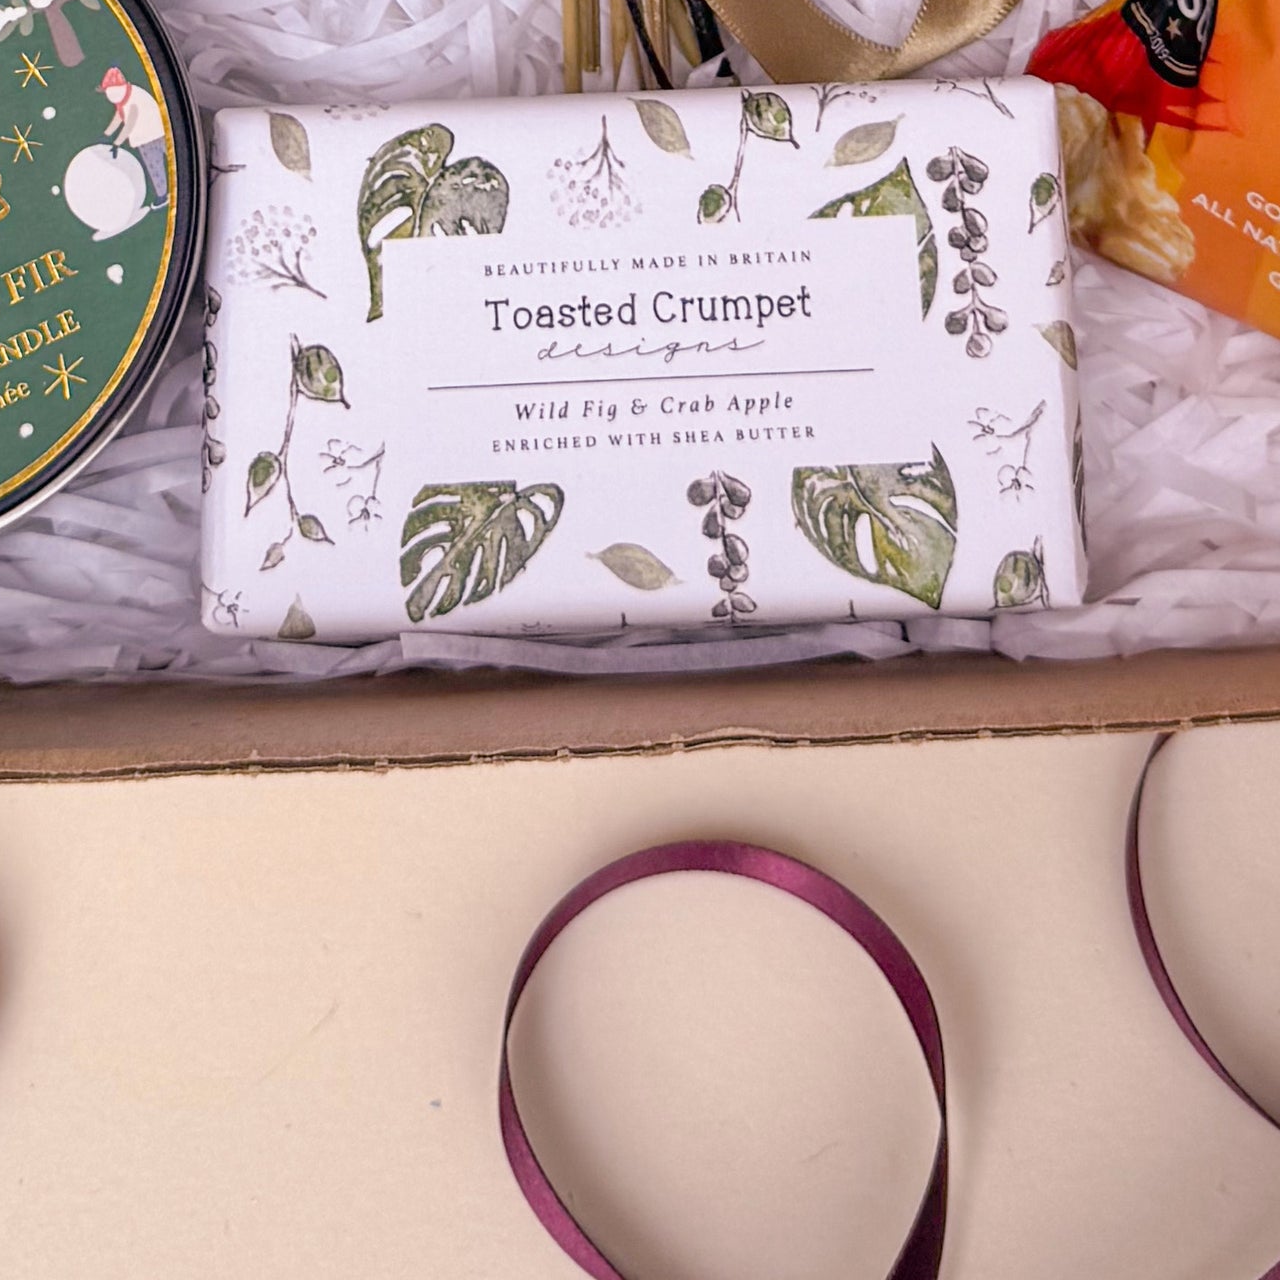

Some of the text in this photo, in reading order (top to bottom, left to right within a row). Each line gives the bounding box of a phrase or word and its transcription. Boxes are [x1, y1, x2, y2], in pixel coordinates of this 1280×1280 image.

[1191, 192, 1236, 228] ALL
[0, 248, 80, 305] FIR
[483, 249, 813, 277] BEAUTIFULLY MADE IN BRITAIN
[484, 285, 812, 331] Toasted Crumpet
[537, 337, 766, 363] designs
[514, 390, 795, 423] Wild Fig & Crab Apple
[492, 425, 817, 453] ENRICHED WITH SHEA BUTTER
